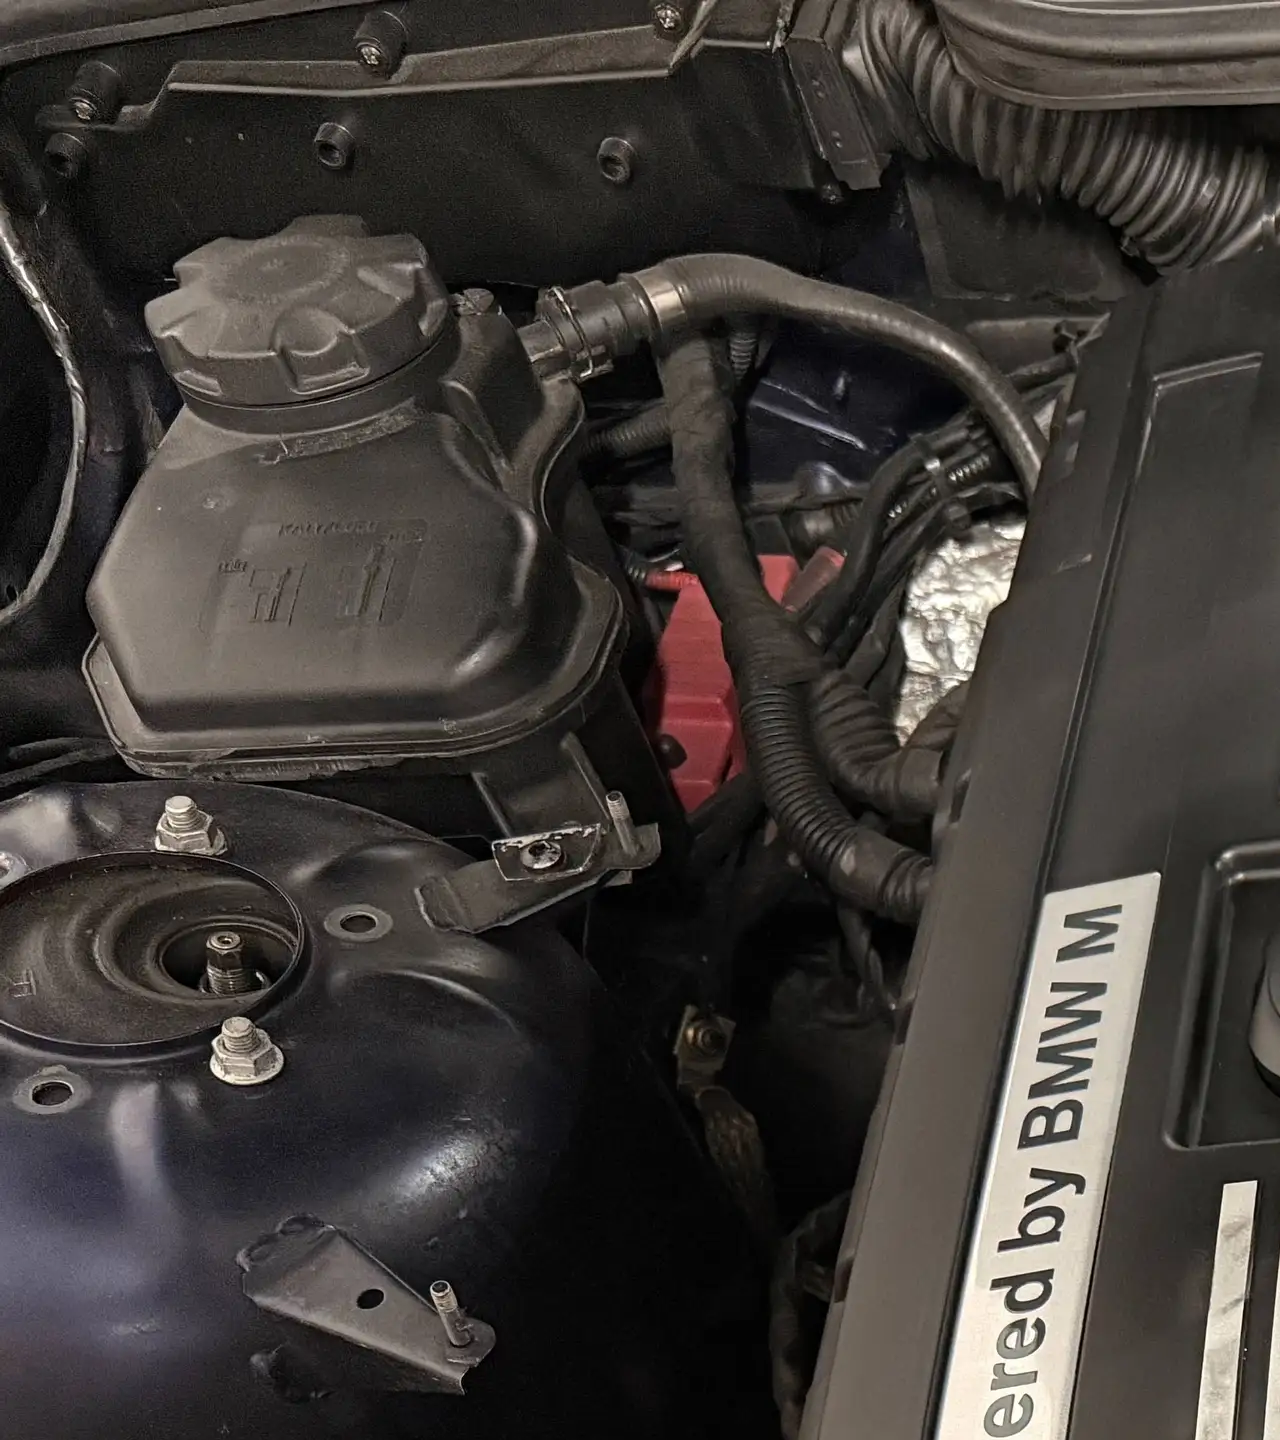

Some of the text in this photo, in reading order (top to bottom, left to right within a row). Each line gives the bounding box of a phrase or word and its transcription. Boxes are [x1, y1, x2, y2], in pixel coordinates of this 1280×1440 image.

[1055, 904, 1123, 963] M
[1017, 982, 1108, 1150] BMW
[997, 1168, 1086, 1253] by
